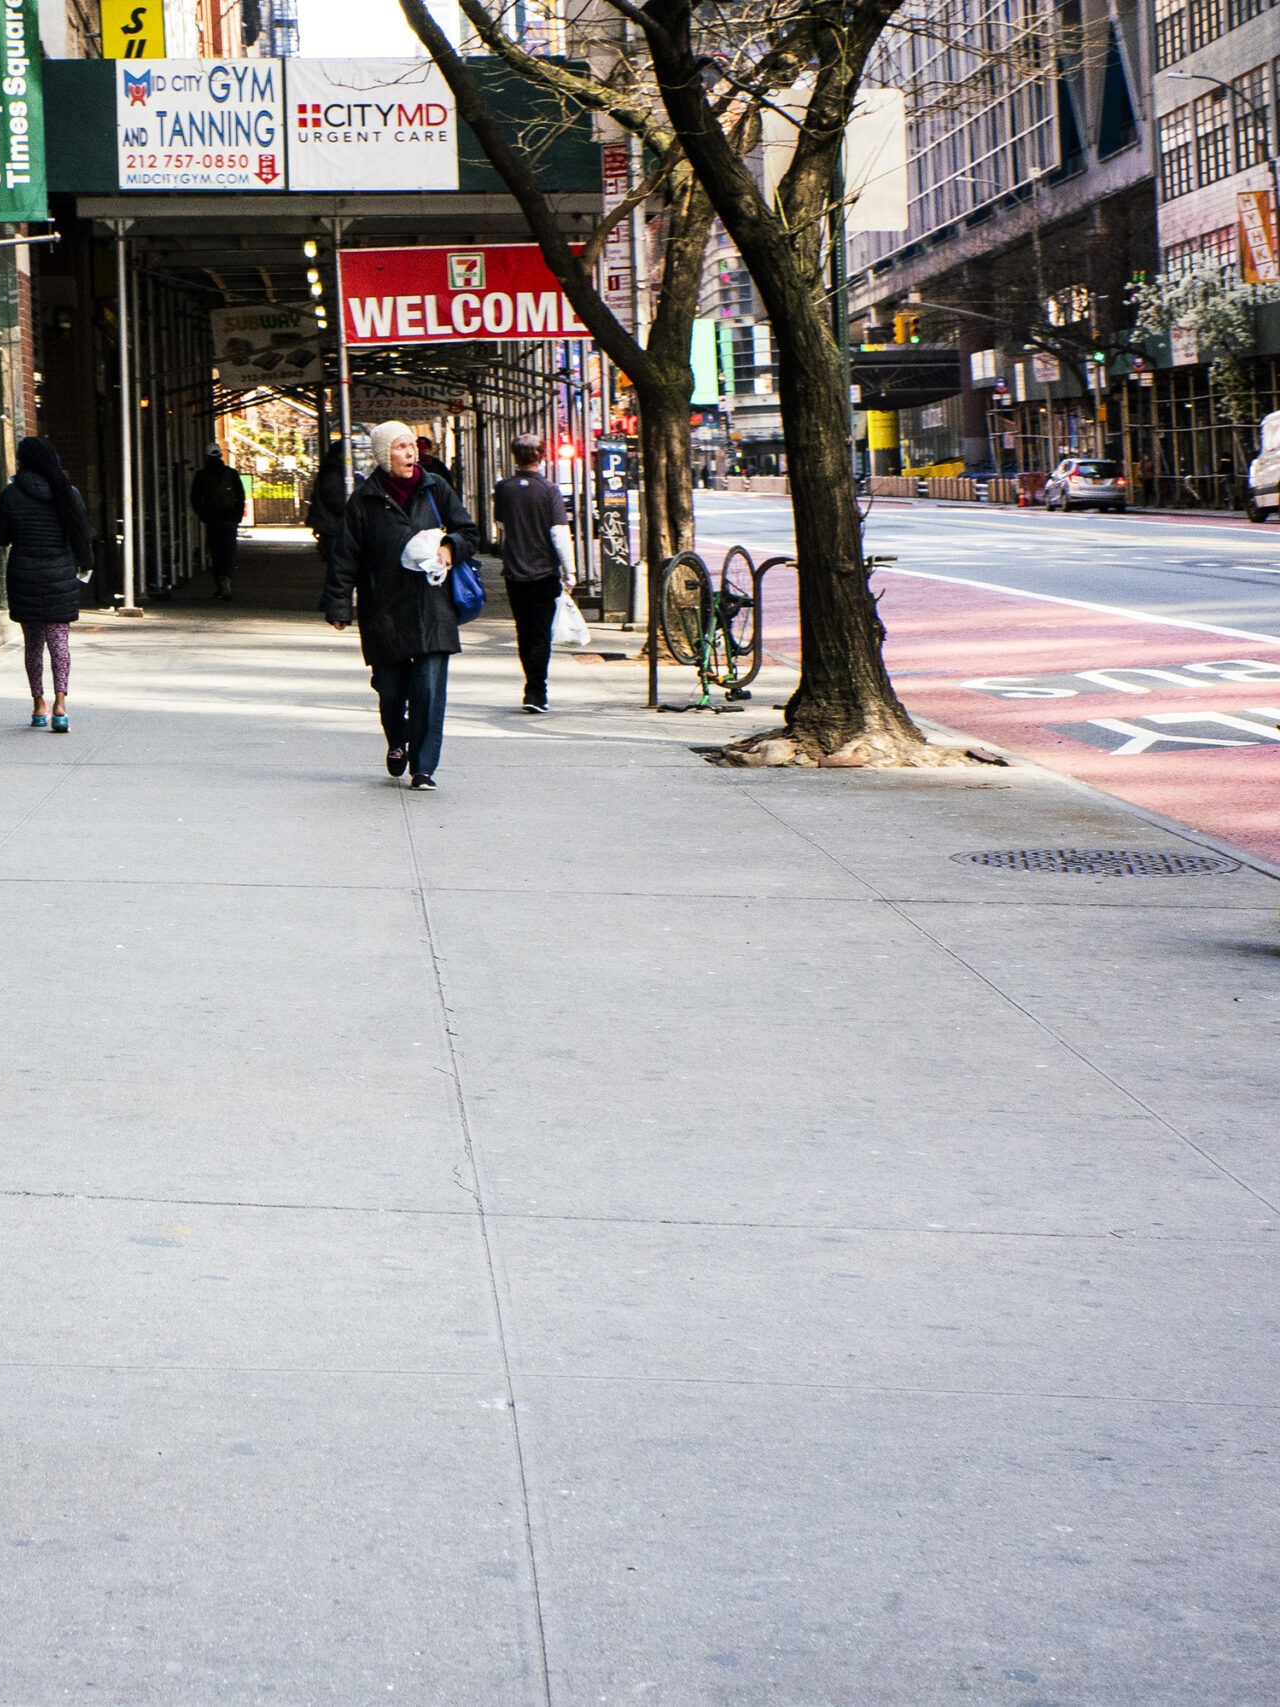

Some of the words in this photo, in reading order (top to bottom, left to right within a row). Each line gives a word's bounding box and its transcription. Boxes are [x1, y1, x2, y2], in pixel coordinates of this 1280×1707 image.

[171, 75, 203, 92] CITY
[208, 65, 276, 103] GYM
[323, 103, 448, 127] CITYMD
[122, 127, 149, 148] AND
[155, 110, 276, 148] TANNING
[297, 131, 383, 143] URGENT
[393, 130, 449, 142] CARE
[5, 101, 31, 189] Times
[126, 154, 158, 169] 212
[164, 154, 250, 169] 757-0850
[125, 173, 251, 185] MIDCITYGYM.COM
[223, 313, 301, 332] SUBWAY
